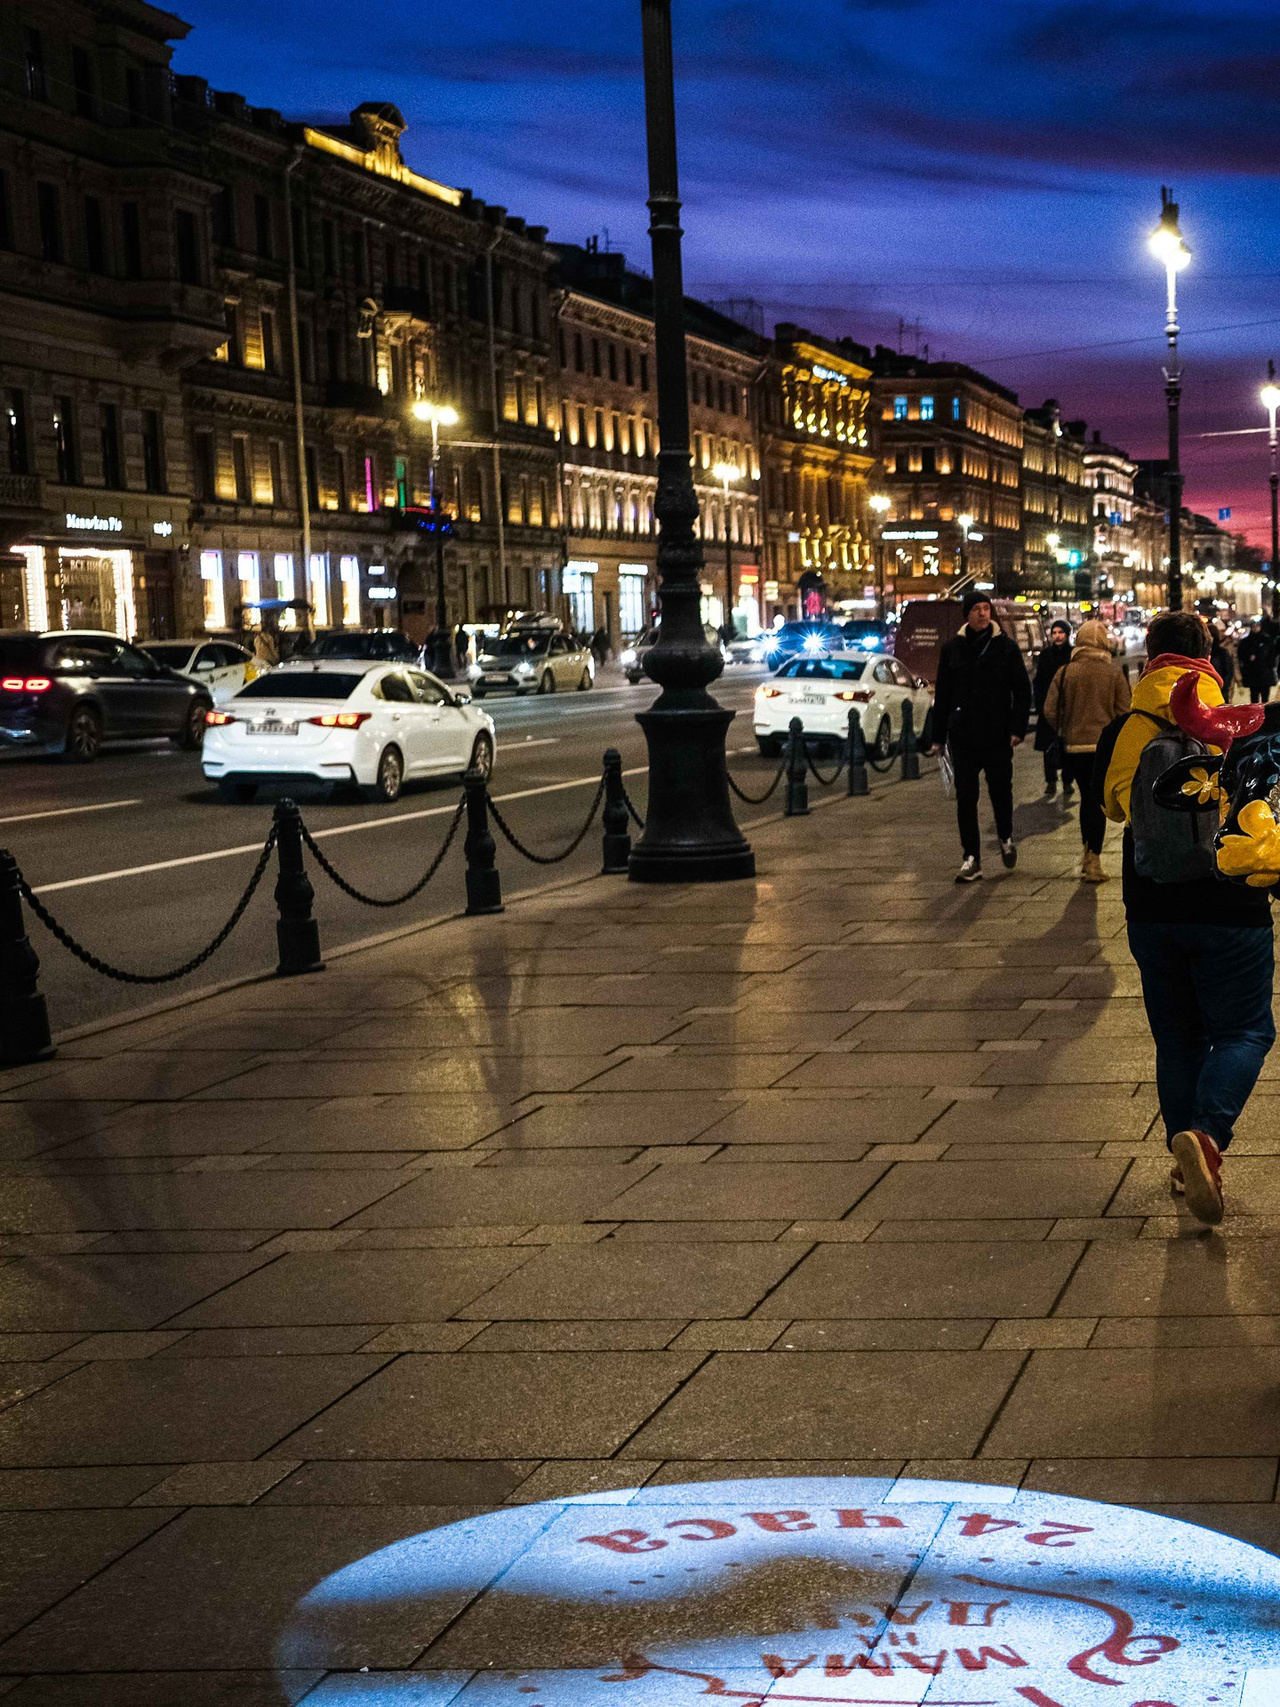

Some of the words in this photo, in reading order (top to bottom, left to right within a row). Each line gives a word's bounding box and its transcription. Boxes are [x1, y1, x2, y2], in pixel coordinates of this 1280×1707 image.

[576, 1508, 909, 1554] часа
[957, 1512, 1095, 1548] 24
[855, 1631, 919, 1650] НА
[761, 1644, 1029, 1679] МАМА
